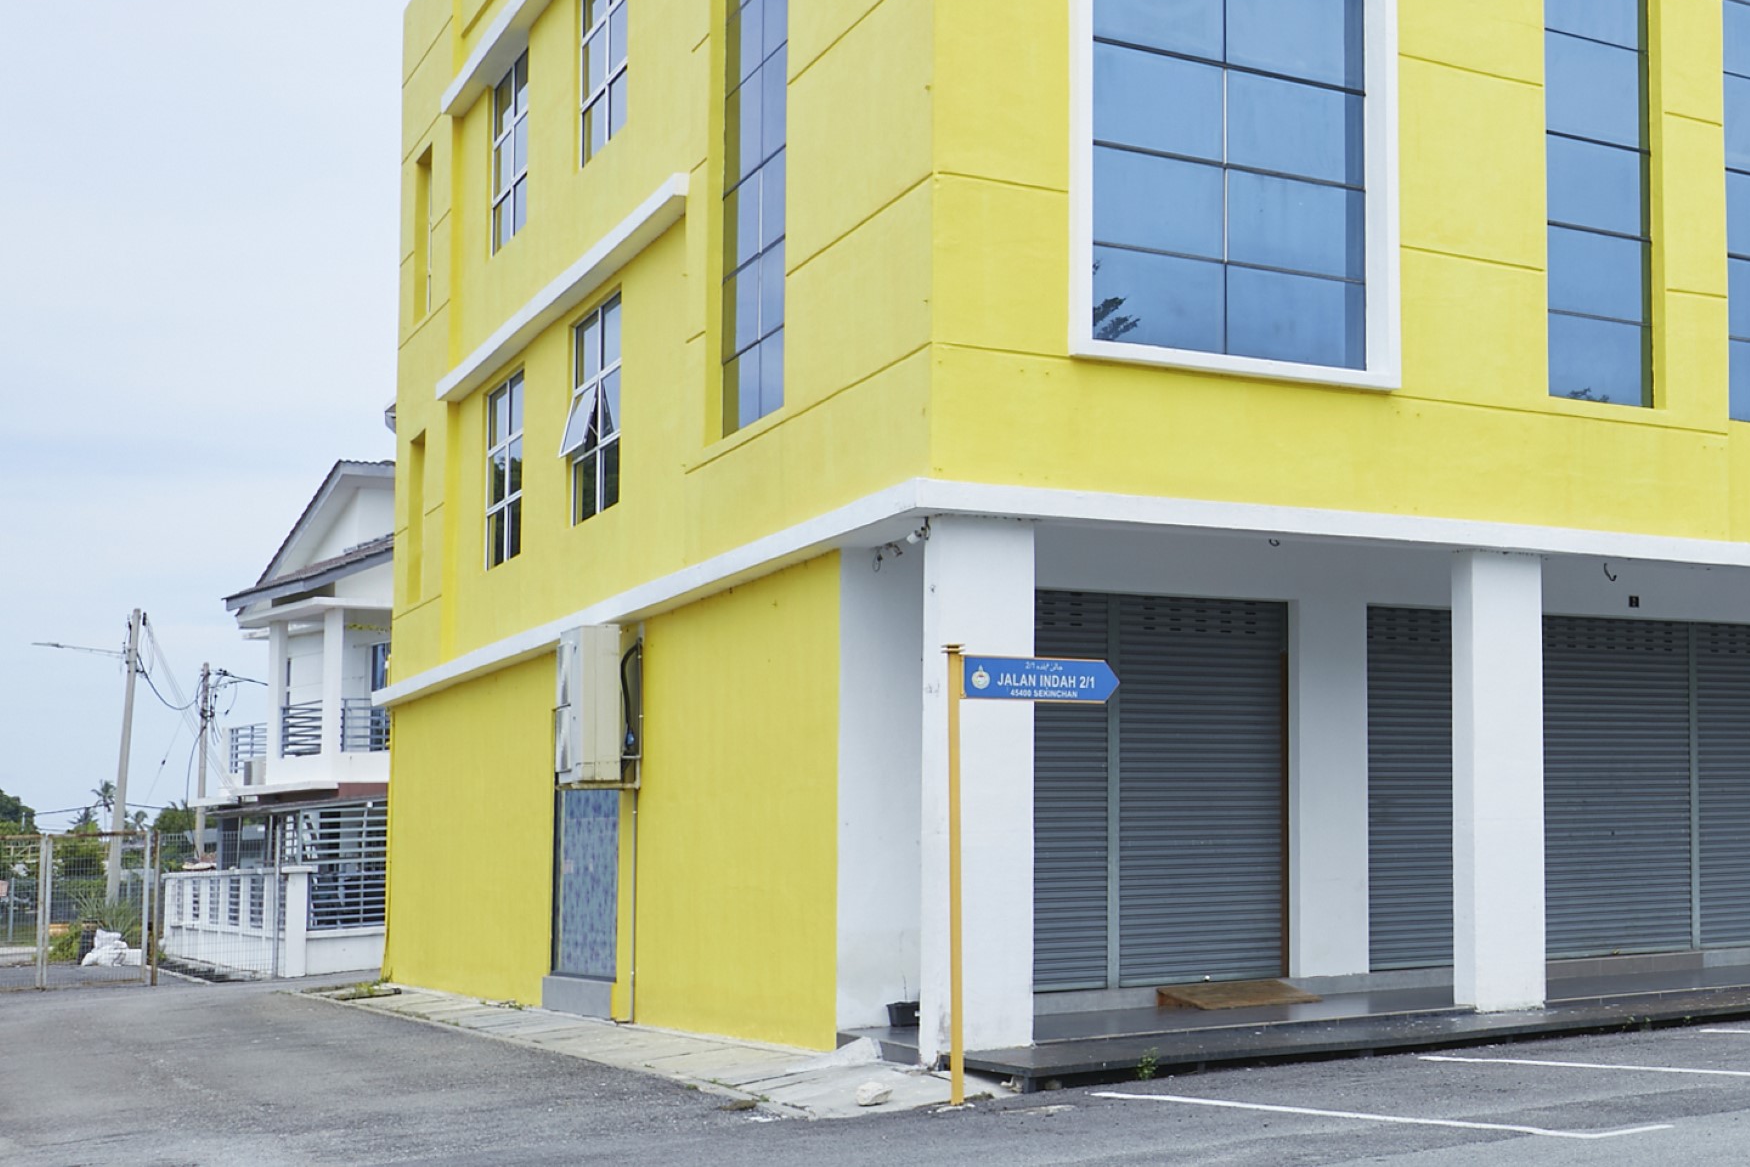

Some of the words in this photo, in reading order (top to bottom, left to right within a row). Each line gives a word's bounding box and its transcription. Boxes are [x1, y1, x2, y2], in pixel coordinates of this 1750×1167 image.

[997, 673, 1036, 688] JALAN
[1039, 674, 1076, 689] INDAH
[1079, 676, 1096, 689] 2/1
[1010, 689, 1032, 698] 45400
[1033, 690, 1078, 699] SEKINCHAN
